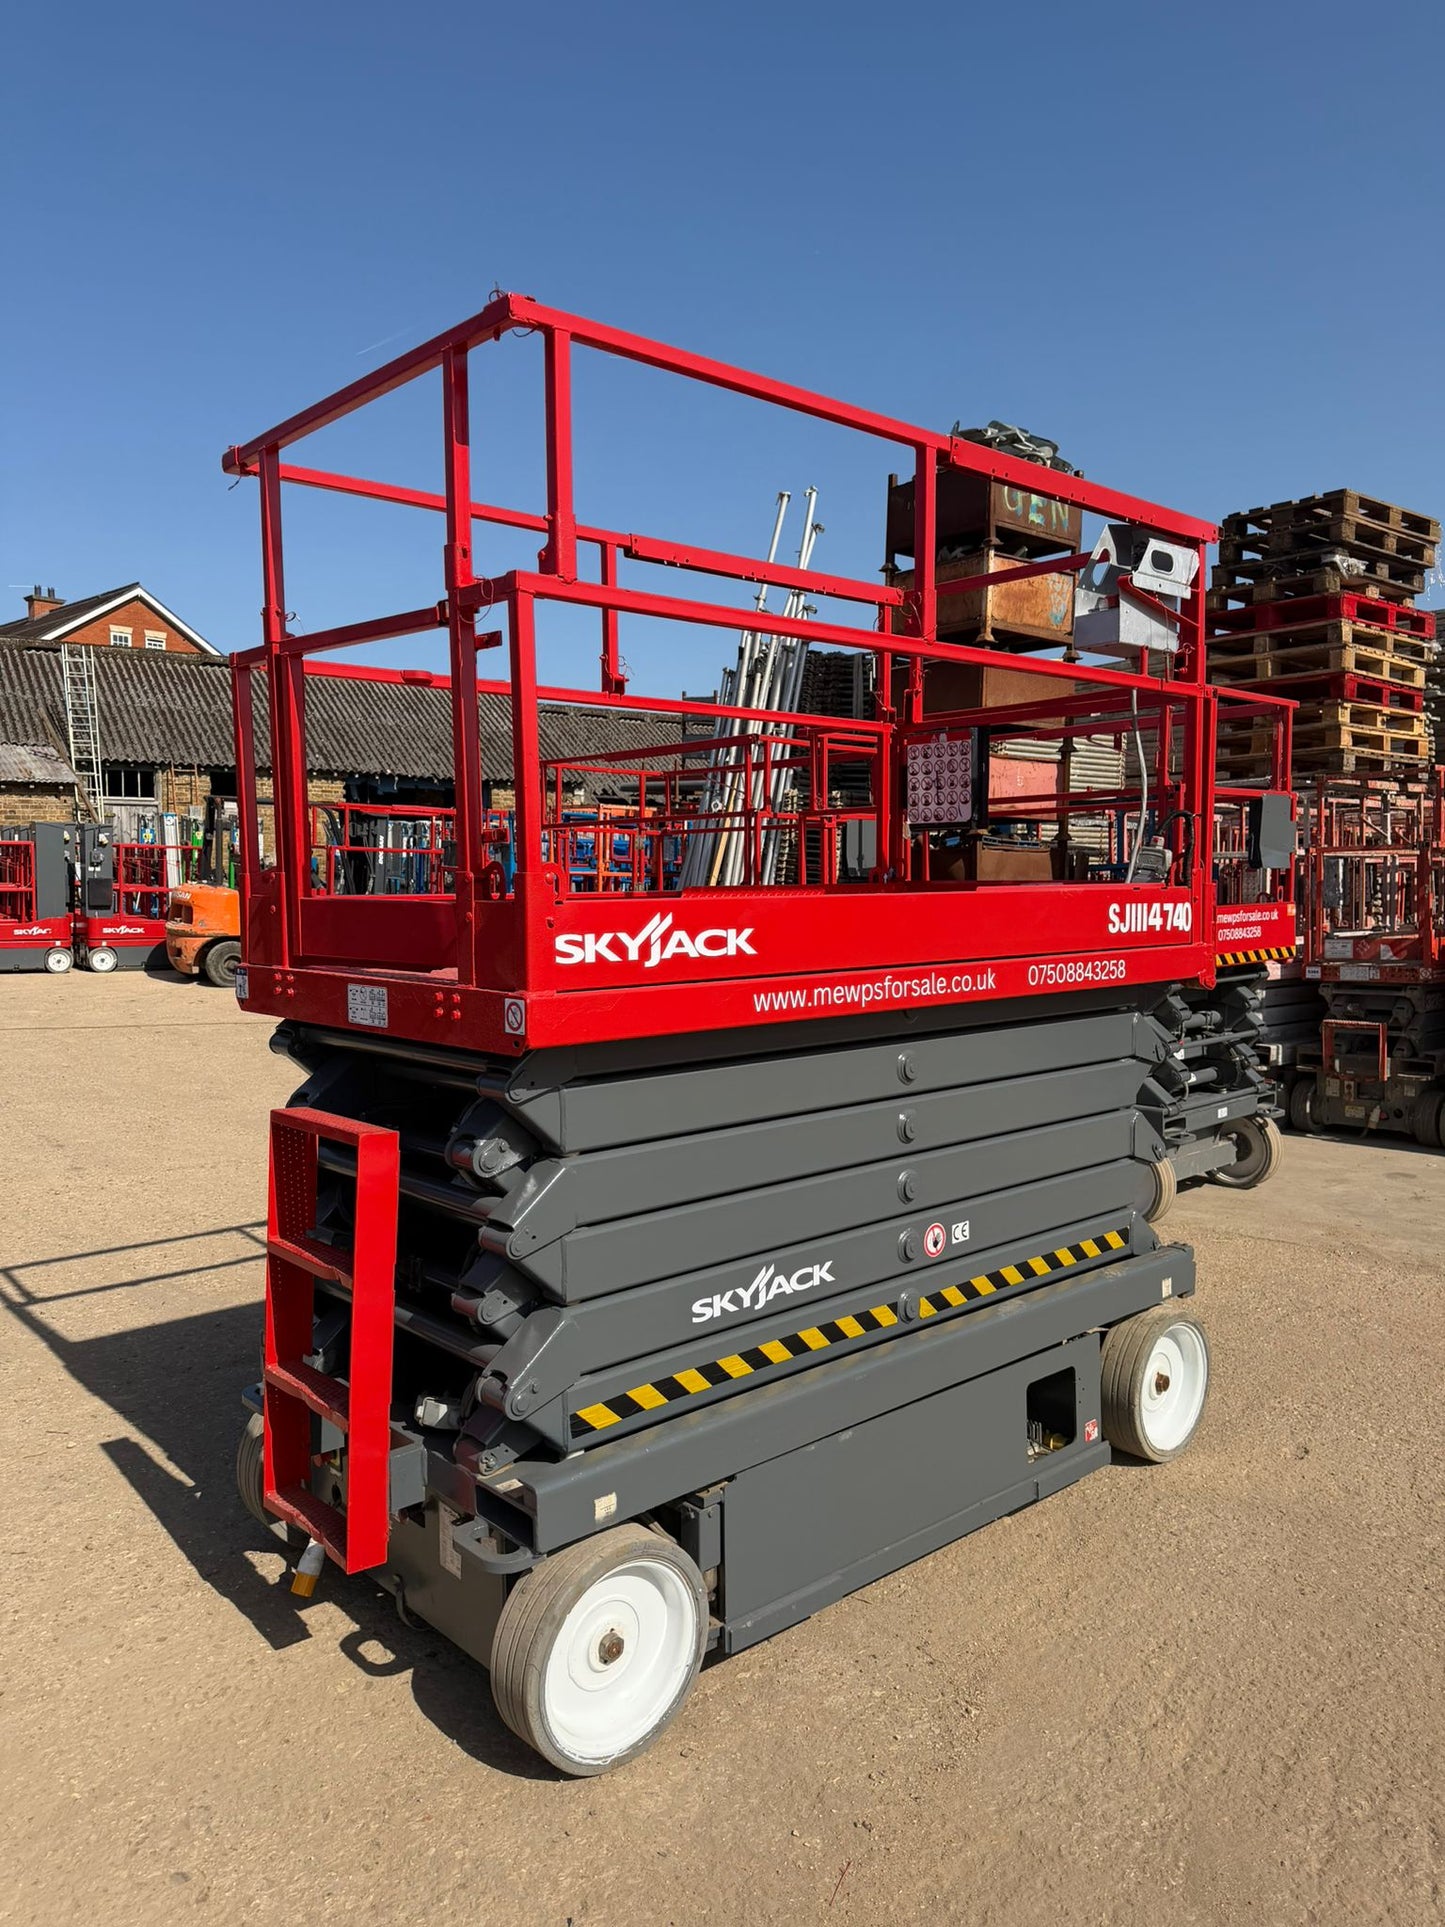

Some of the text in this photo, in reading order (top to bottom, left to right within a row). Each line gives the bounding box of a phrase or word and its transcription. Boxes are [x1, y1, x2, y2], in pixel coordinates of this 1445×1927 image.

[102, 924, 146, 935] SKYJACK
[554, 911, 758, 968] SKYJACK
[753, 959, 1127, 1013] www.mewpsforsale.co.uk 07508843258
[953, 1222, 968, 1241] CE
[691, 1260, 836, 1324] SKYJACK
